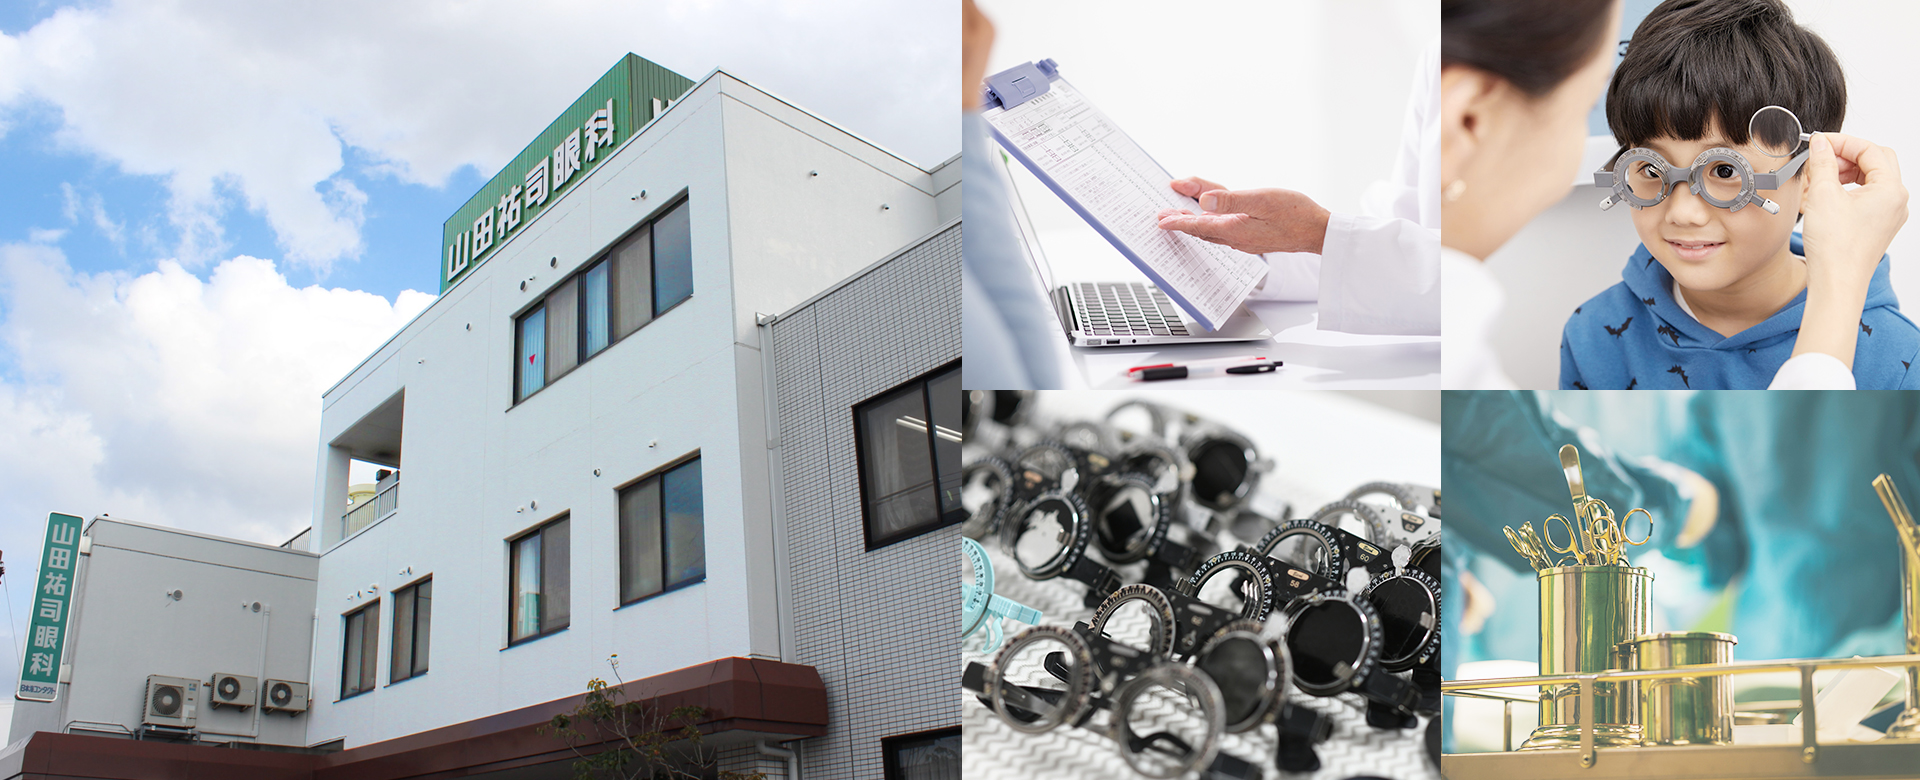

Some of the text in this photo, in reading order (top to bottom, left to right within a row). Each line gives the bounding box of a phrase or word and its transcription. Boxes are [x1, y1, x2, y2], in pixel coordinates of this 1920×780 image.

[447, 97, 616, 282] 山田祐司眼科
[1290, 579, 1300, 588] 58
[1359, 553, 1370, 562] 60
[29, 522, 76, 677] 山田祐司眼科
